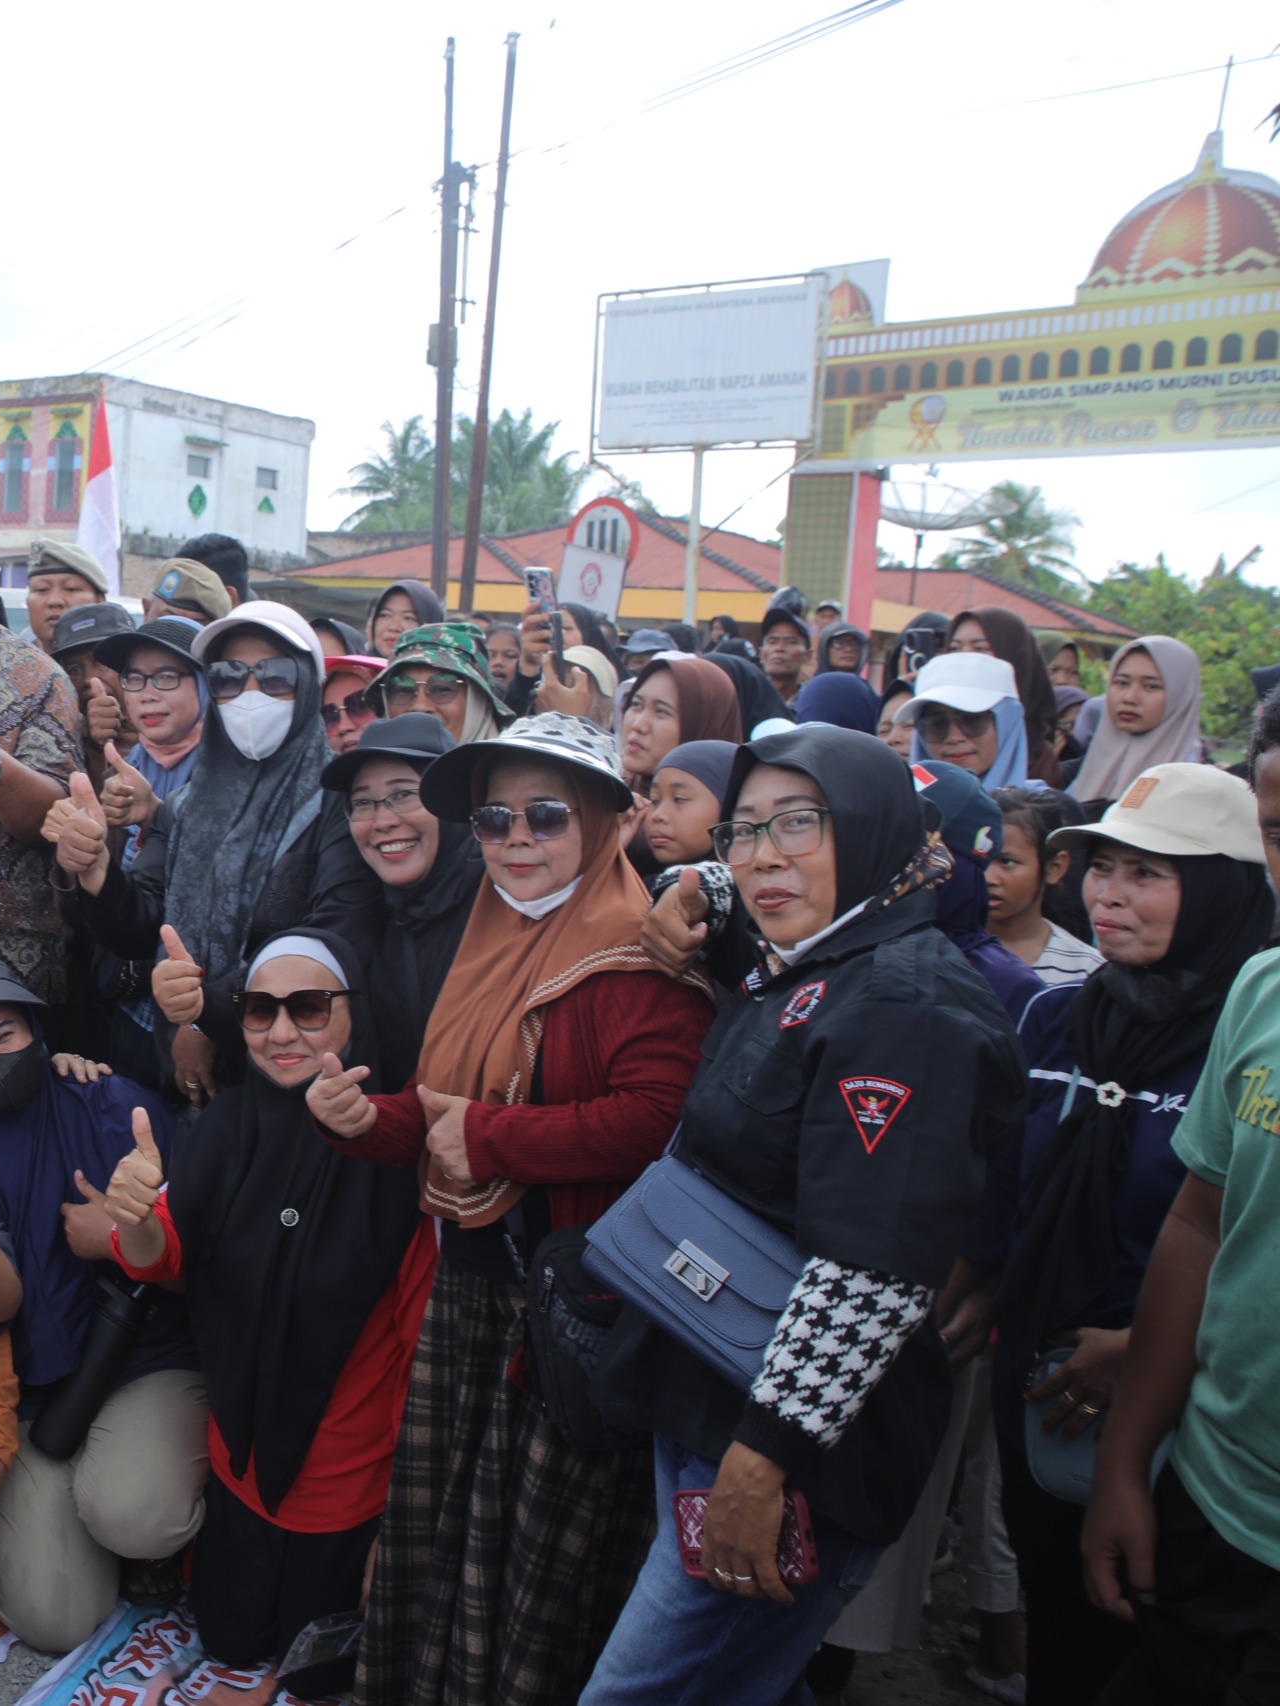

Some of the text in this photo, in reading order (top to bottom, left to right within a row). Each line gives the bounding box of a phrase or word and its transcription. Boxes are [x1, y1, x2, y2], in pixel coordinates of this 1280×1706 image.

[605, 371, 808, 397] RUMAH REHABILITASI NAPZA AMANAH
[998, 386, 1064, 402] WARGA
[1068, 378, 1154, 398] SIMPANG
[1158, 374, 1220, 391] MURNI
[1061, 411, 1156, 446] Puasa
